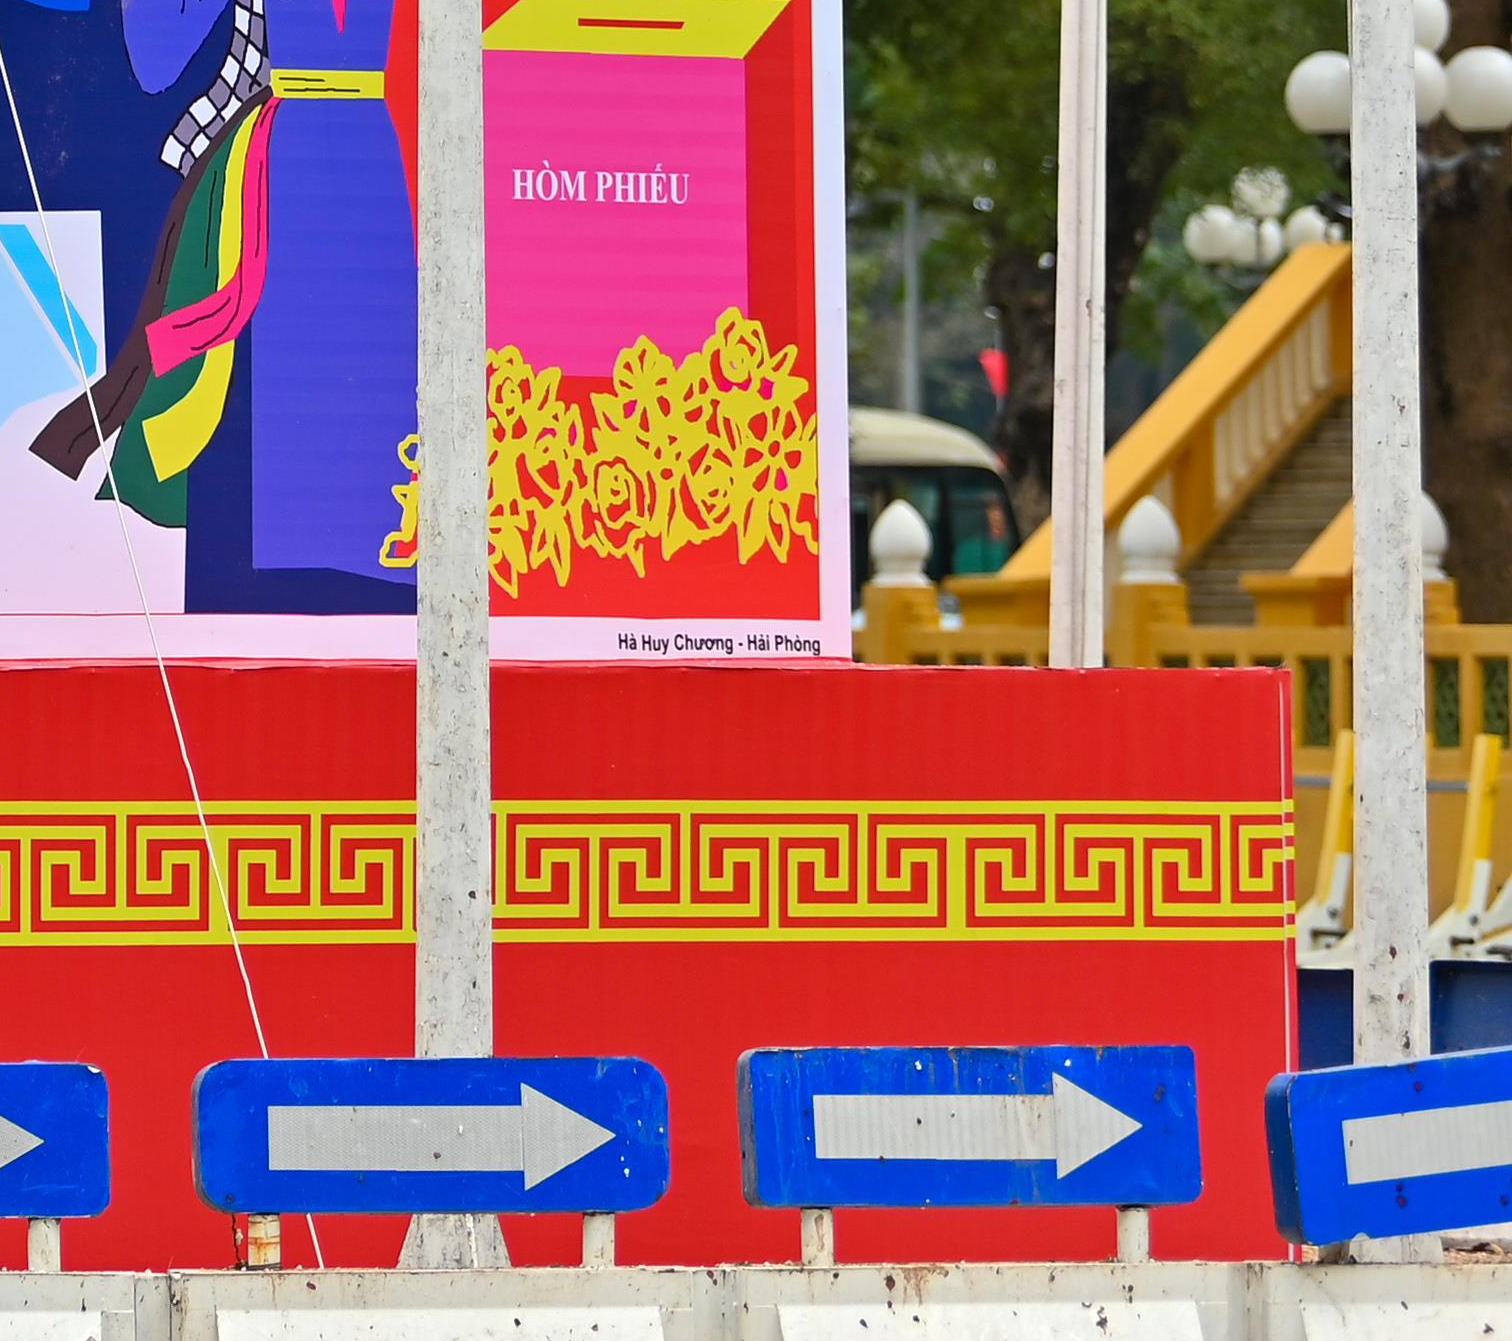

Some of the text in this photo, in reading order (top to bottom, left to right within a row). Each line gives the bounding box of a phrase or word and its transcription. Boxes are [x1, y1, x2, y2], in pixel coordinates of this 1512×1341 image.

[512, 160, 690, 205] HÒM PHIẾU
[618, 633, 637, 651] Hà
[641, 635, 670, 655] Huy
[674, 634, 734, 655] Chương
[774, 635, 821, 656] Phòng
